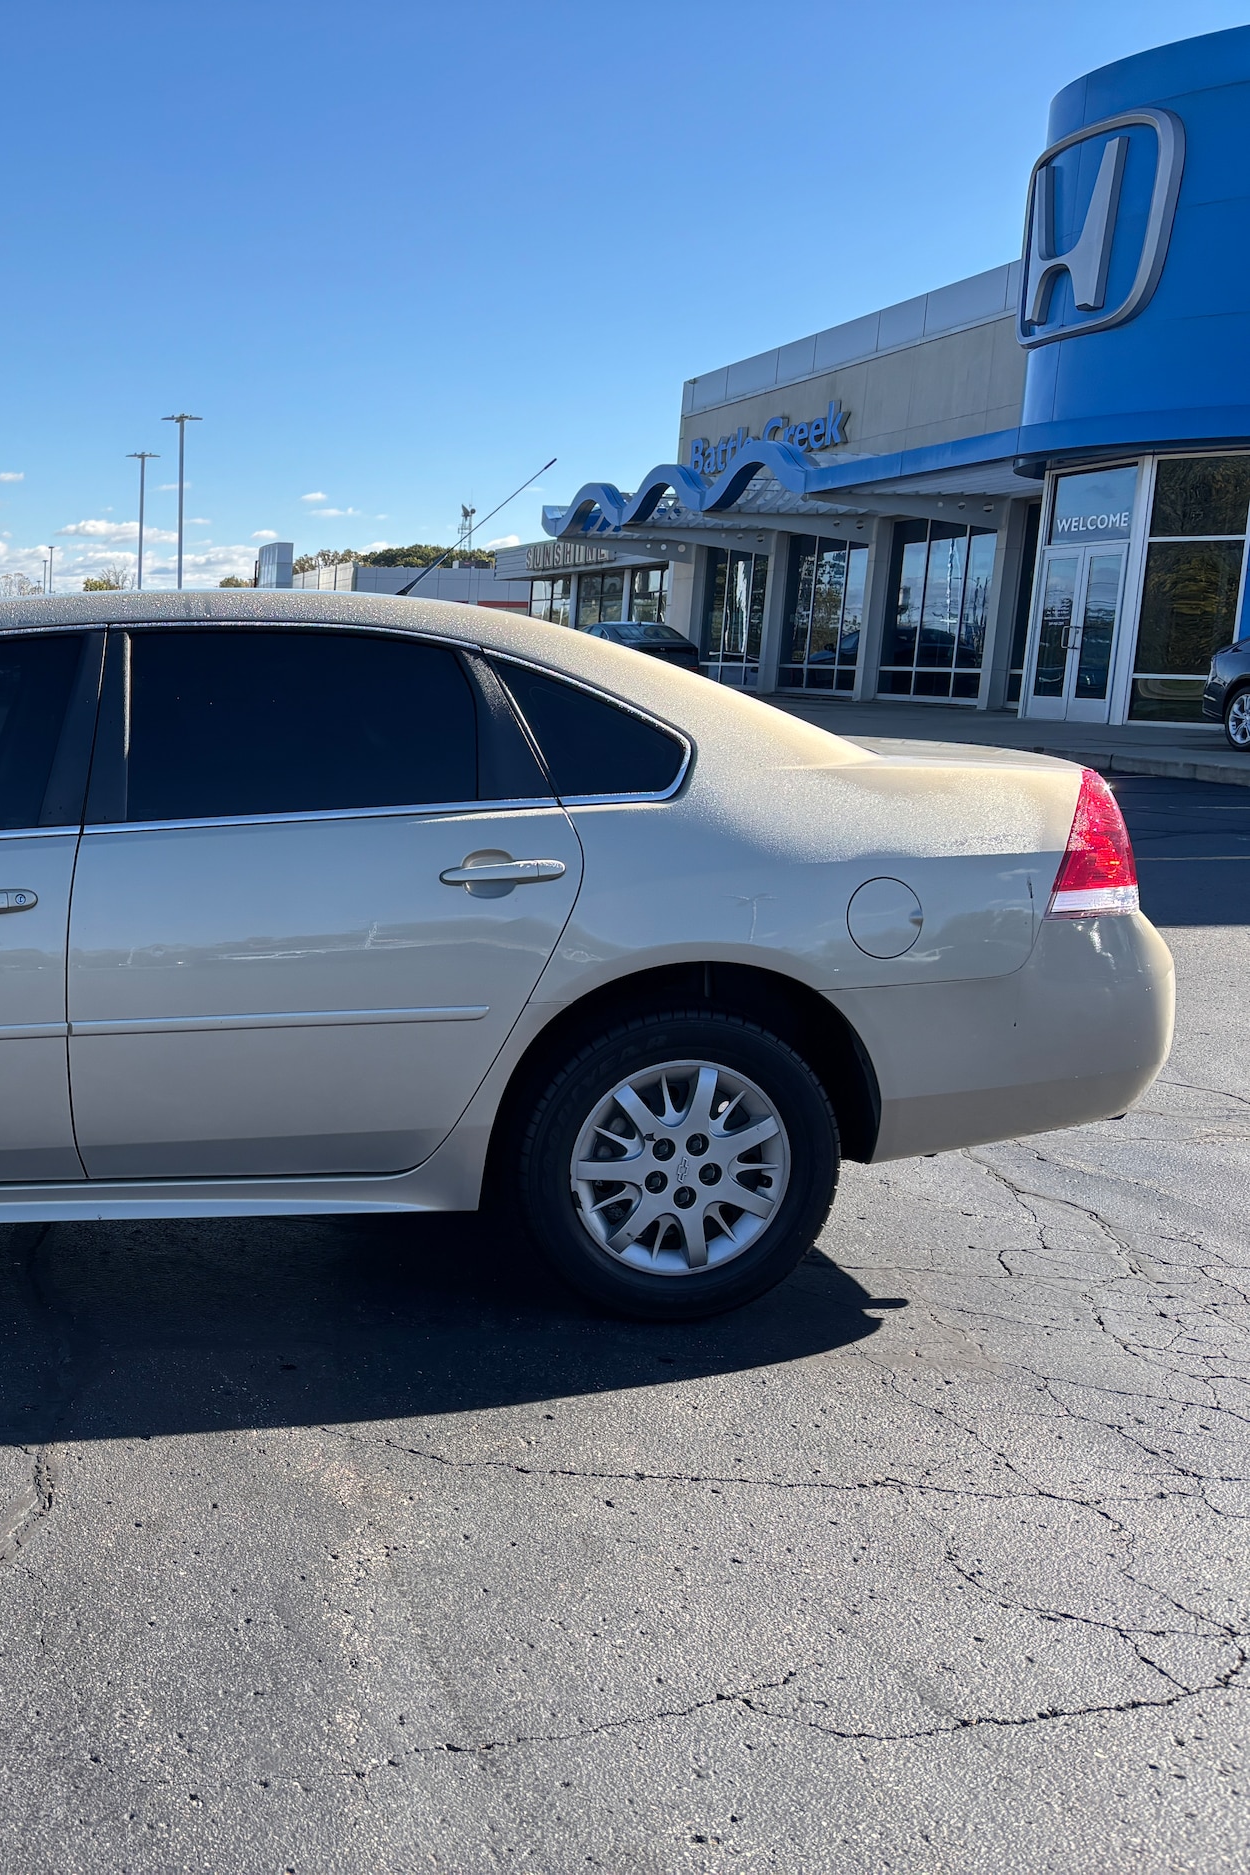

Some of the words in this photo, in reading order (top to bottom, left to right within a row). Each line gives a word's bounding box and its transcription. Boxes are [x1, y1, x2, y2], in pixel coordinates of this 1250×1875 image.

[691, 426, 751, 475] Battl
[763, 400, 848, 451] Creek
[1057, 512, 1130, 533] WELCOME
